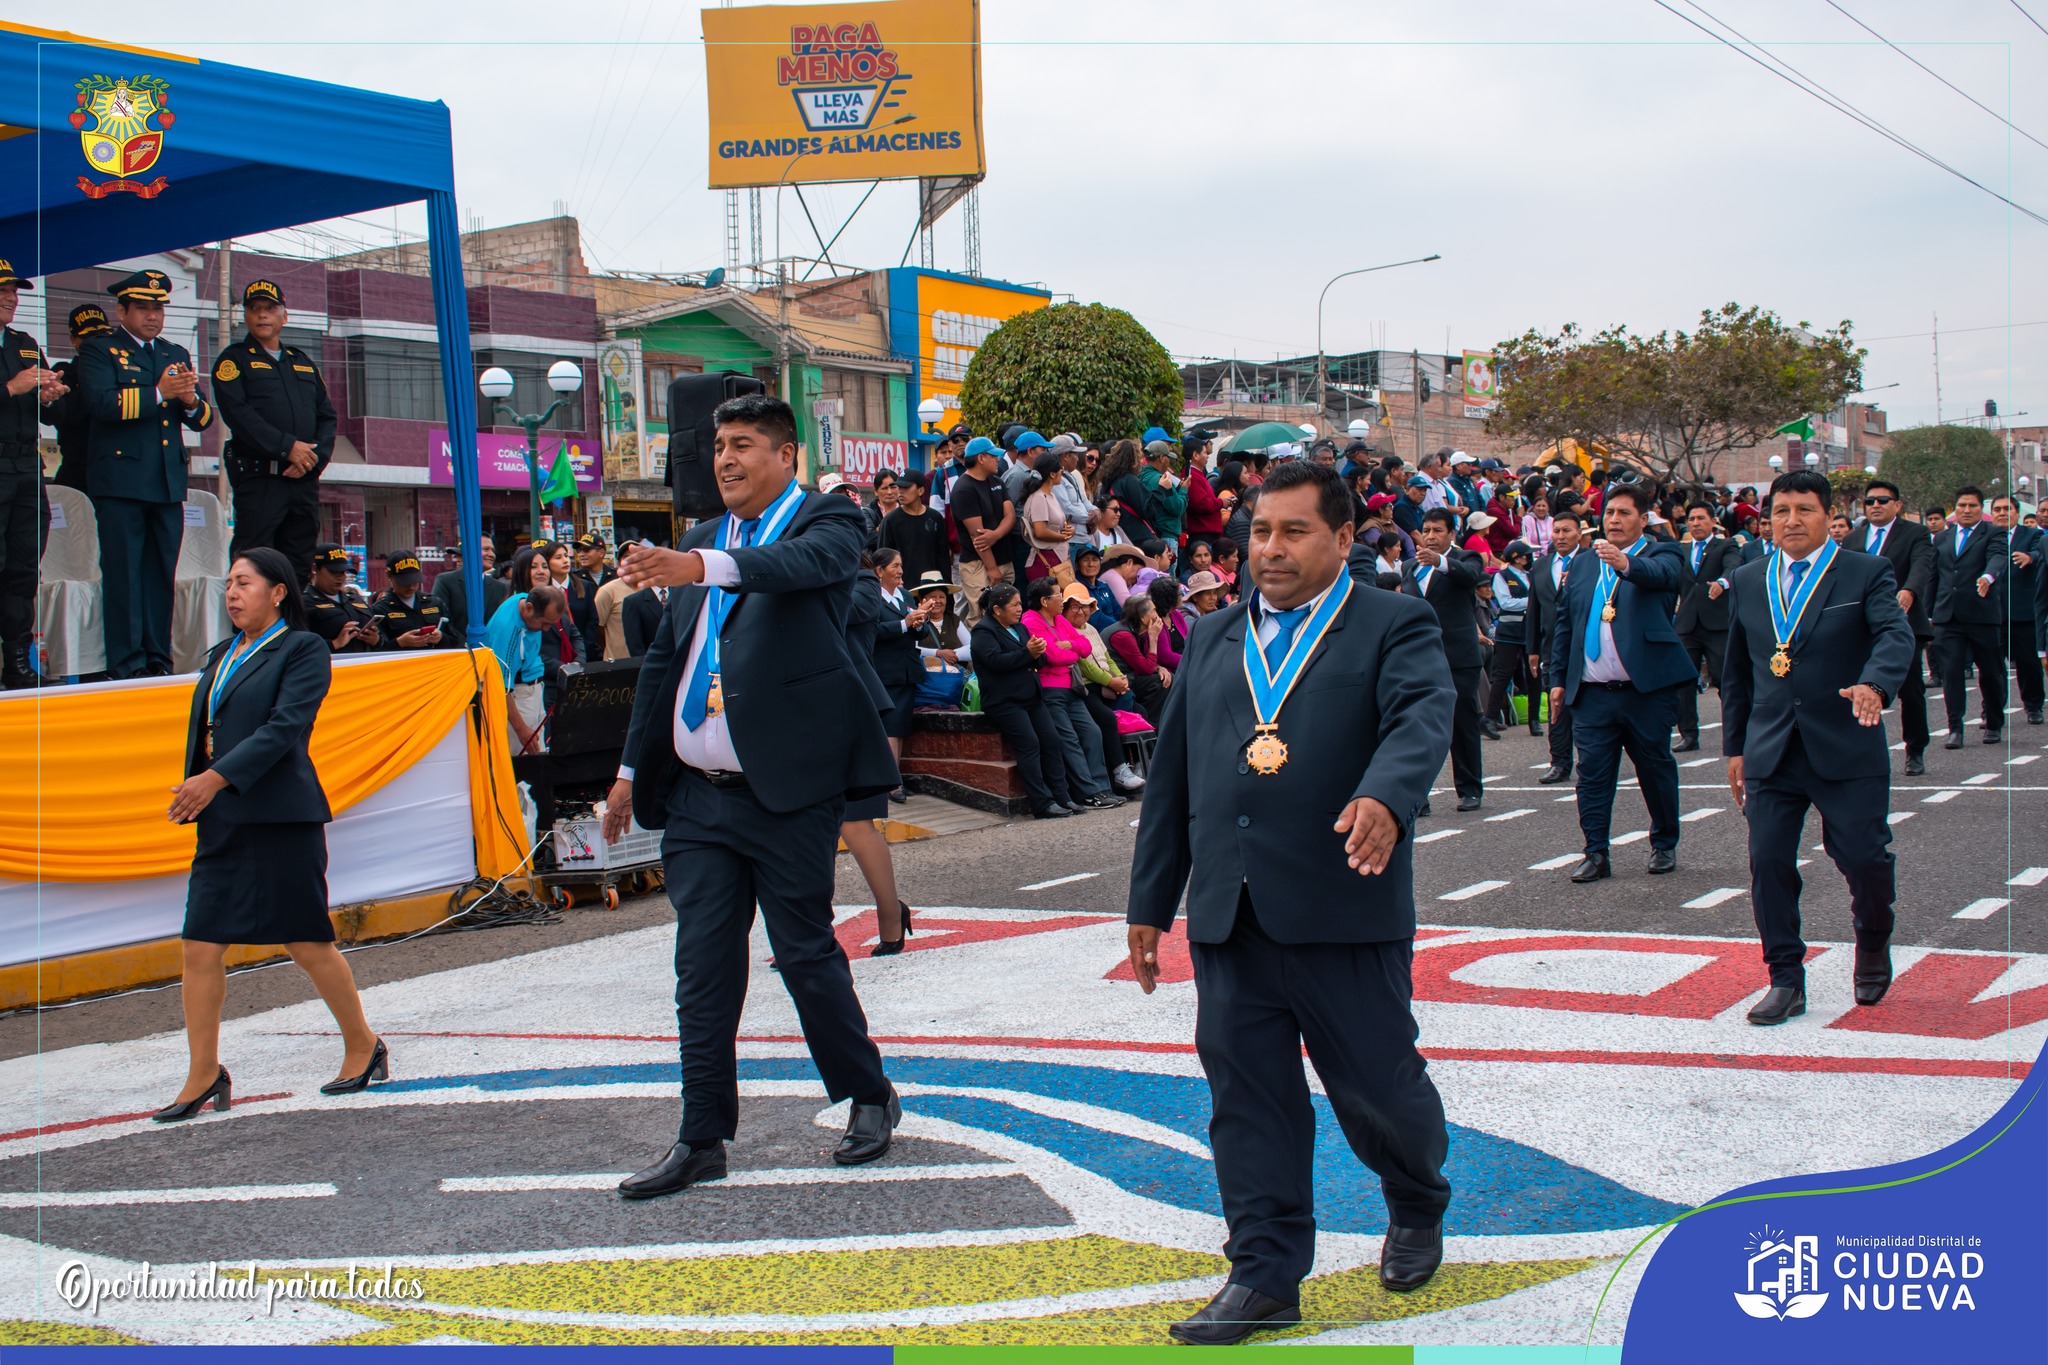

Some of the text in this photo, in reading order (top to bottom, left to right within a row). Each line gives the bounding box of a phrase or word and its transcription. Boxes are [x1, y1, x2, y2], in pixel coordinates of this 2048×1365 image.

[791, 21, 884, 54] PAGA
[777, 50, 899, 86] MENOS
[814, 93, 864, 108] LLEVA
[823, 106, 859, 124] MÁS
[718, 130, 961, 158] GRANDES ALMACENES
[246, 281, 278, 299] POLICIA
[74, 309, 105, 326] POLICIA
[815, 401, 837, 416] BOTICA
[843, 439, 906, 476] BOTICA
[395, 557, 420, 574] POLICIA
